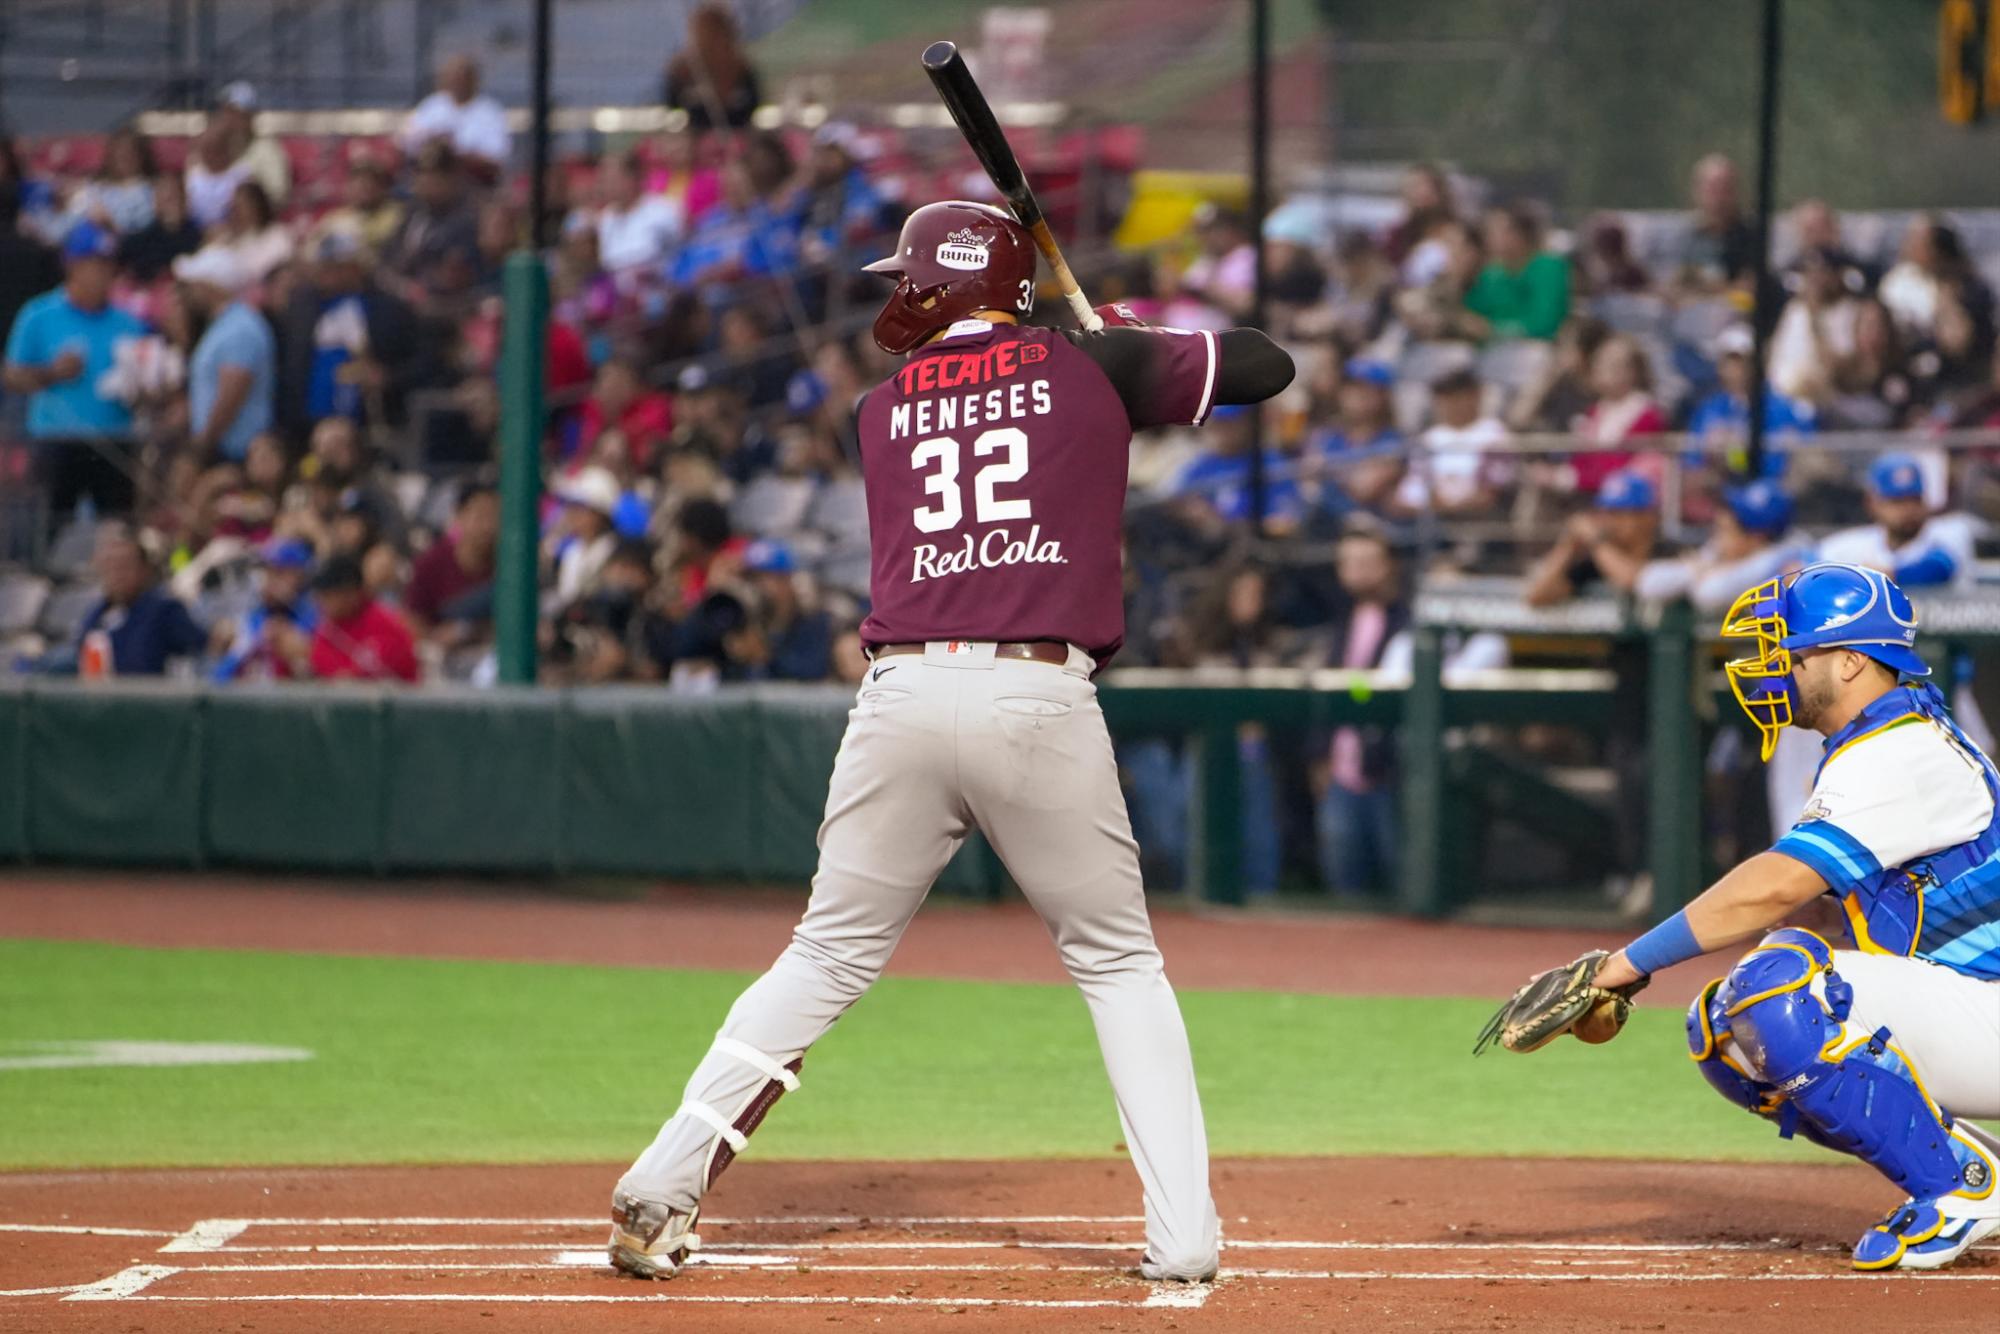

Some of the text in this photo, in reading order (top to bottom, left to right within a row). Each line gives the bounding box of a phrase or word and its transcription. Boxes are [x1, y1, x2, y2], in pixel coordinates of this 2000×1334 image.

[940, 250, 985, 264] BURR
[897, 341, 1021, 396] TECATE
[890, 379, 1051, 440] MENESES
[911, 427, 1032, 533] 32
